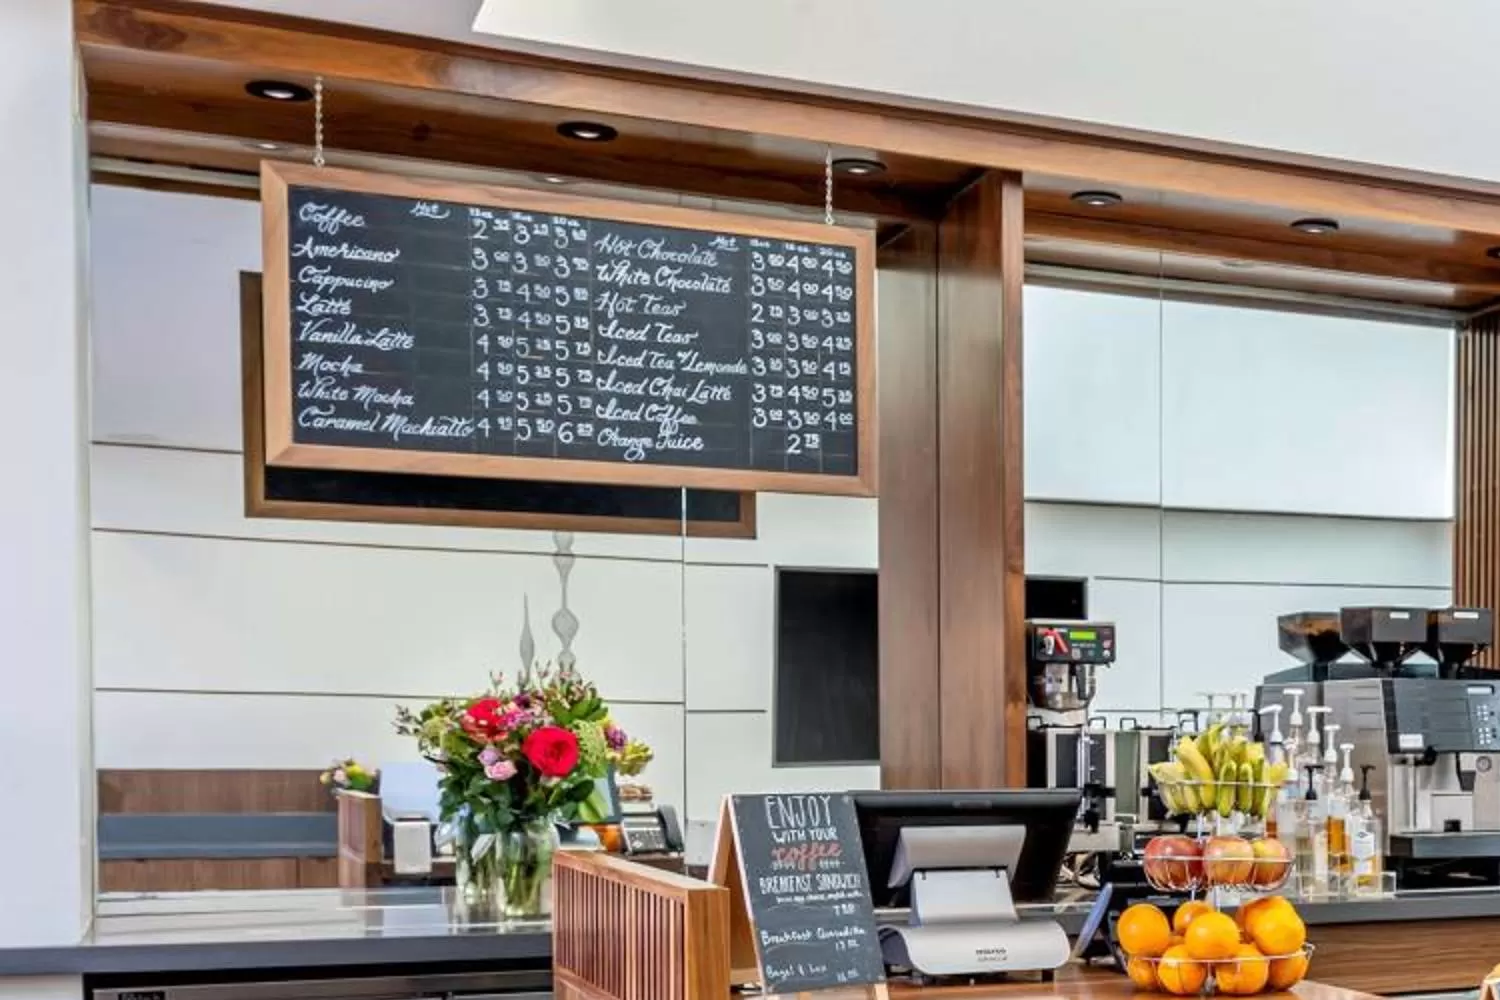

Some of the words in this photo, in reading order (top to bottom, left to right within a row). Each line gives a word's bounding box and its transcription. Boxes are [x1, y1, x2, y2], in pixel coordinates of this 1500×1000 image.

[300, 202, 365, 235] Coffee
[292, 236, 400, 263] Americano
[594, 233, 637, 256] Hot
[637, 238, 719, 267] Chocolate
[596, 259, 651, 288] White
[654, 265, 733, 293] Chocolate
[296, 292, 351, 316] Latte
[594, 290, 638, 319] Hot
[298, 318, 363, 345] Vanilla
[363, 328, 415, 350] Latte
[598, 319, 651, 341] Iced
[298, 352, 363, 378] Mocha
[597, 345, 648, 368] Iced
[649, 351, 675, 370] Tea
[297, 376, 349, 400] White
[353, 384, 415, 412] Mocha
[596, 369, 649, 395] Iced
[649, 374, 688, 401] Chai
[686, 379, 732, 405] Latte
[298, 404, 381, 432] Caramel
[595, 398, 645, 421] Iced
[645, 404, 699, 436] Coffee
[597, 428, 653, 461] Orange
[655, 433, 704, 450] Juice
[764, 795, 831, 829] ENJOY
[771, 829, 806, 844] WITH
[808, 827, 838, 841] YOUR
